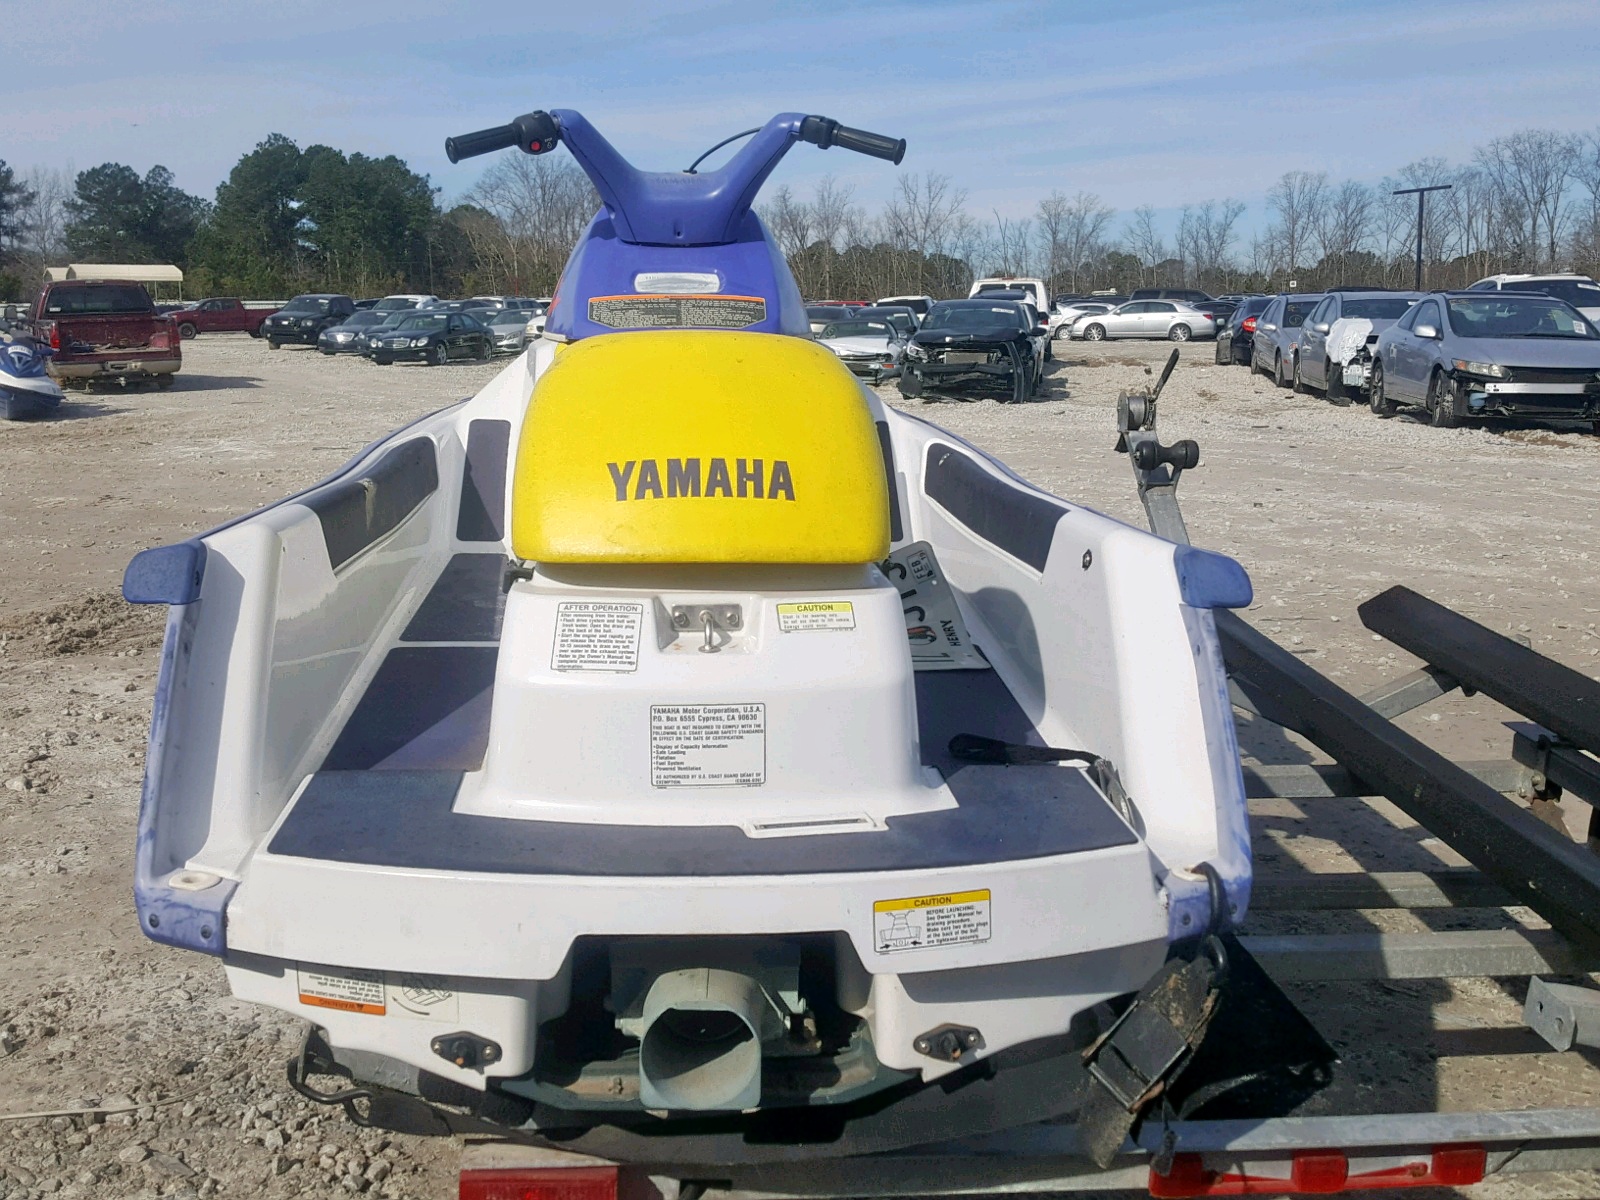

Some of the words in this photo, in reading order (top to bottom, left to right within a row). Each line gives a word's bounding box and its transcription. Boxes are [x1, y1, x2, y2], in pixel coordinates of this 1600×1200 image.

[606, 458, 796, 502] YAMAHA
[911, 560, 928, 580] FEB
[940, 620, 962, 646] HENRY
[703, 707, 740, 715] Corporation,
[698, 714, 724, 723] Cypress,
[914, 897, 951, 906] CAUTION
